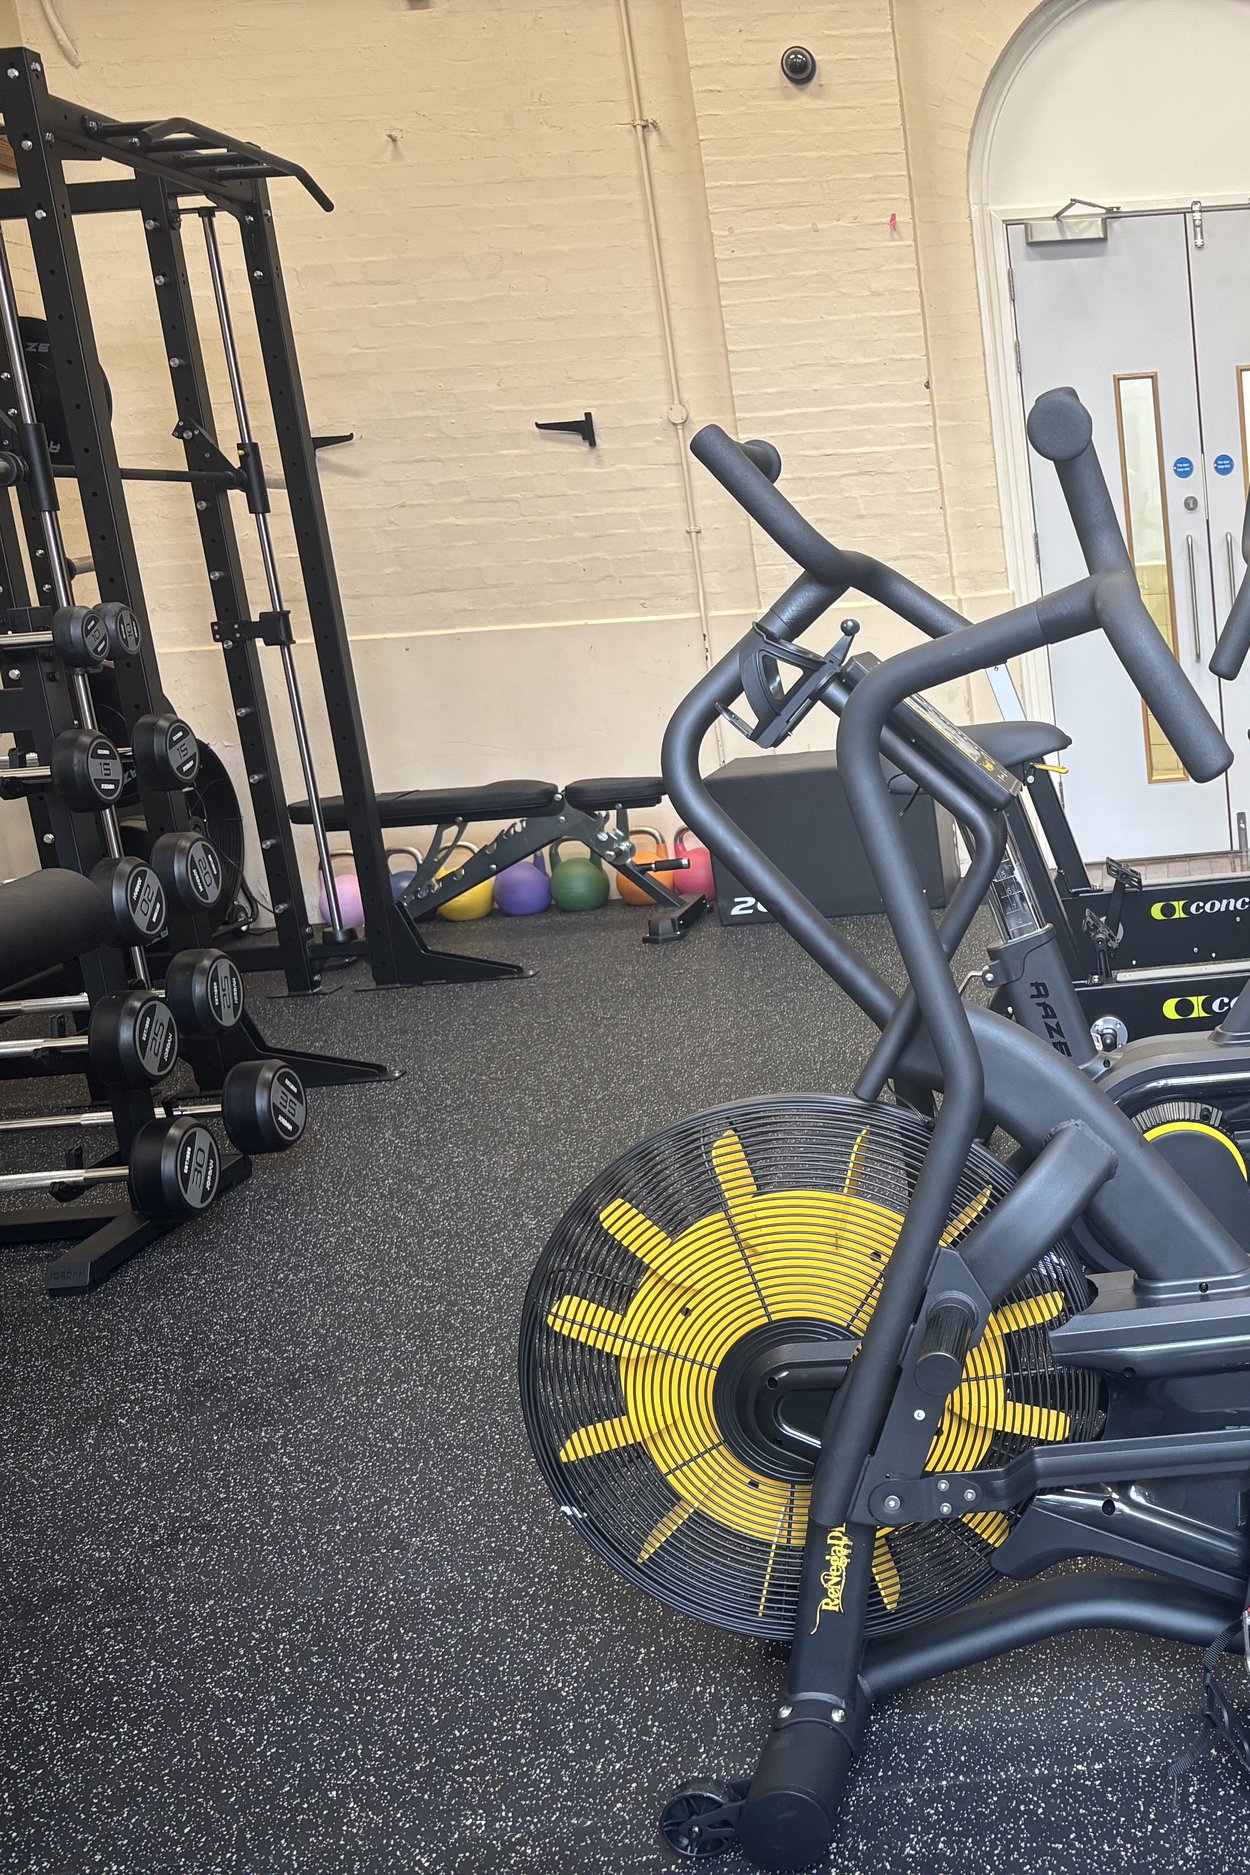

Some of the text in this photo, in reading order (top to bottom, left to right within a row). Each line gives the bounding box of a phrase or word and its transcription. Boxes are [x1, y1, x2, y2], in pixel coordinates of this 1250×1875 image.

[91, 628, 101, 642] 10
[176, 743, 189, 760] 15
[99, 762, 112, 777] 15
[198, 857, 213, 888] 20
[140, 882, 155, 916] 20
[221, 975, 232, 1009] 25
[1029, 980, 1072, 1057] RAZE
[149, 1019, 165, 1058] 25
[163, 1032, 173, 1063] JORDAN
[279, 1089, 298, 1118] 35
[191, 1147, 206, 1190] 30
[206, 1159, 214, 1191] JORDAN
